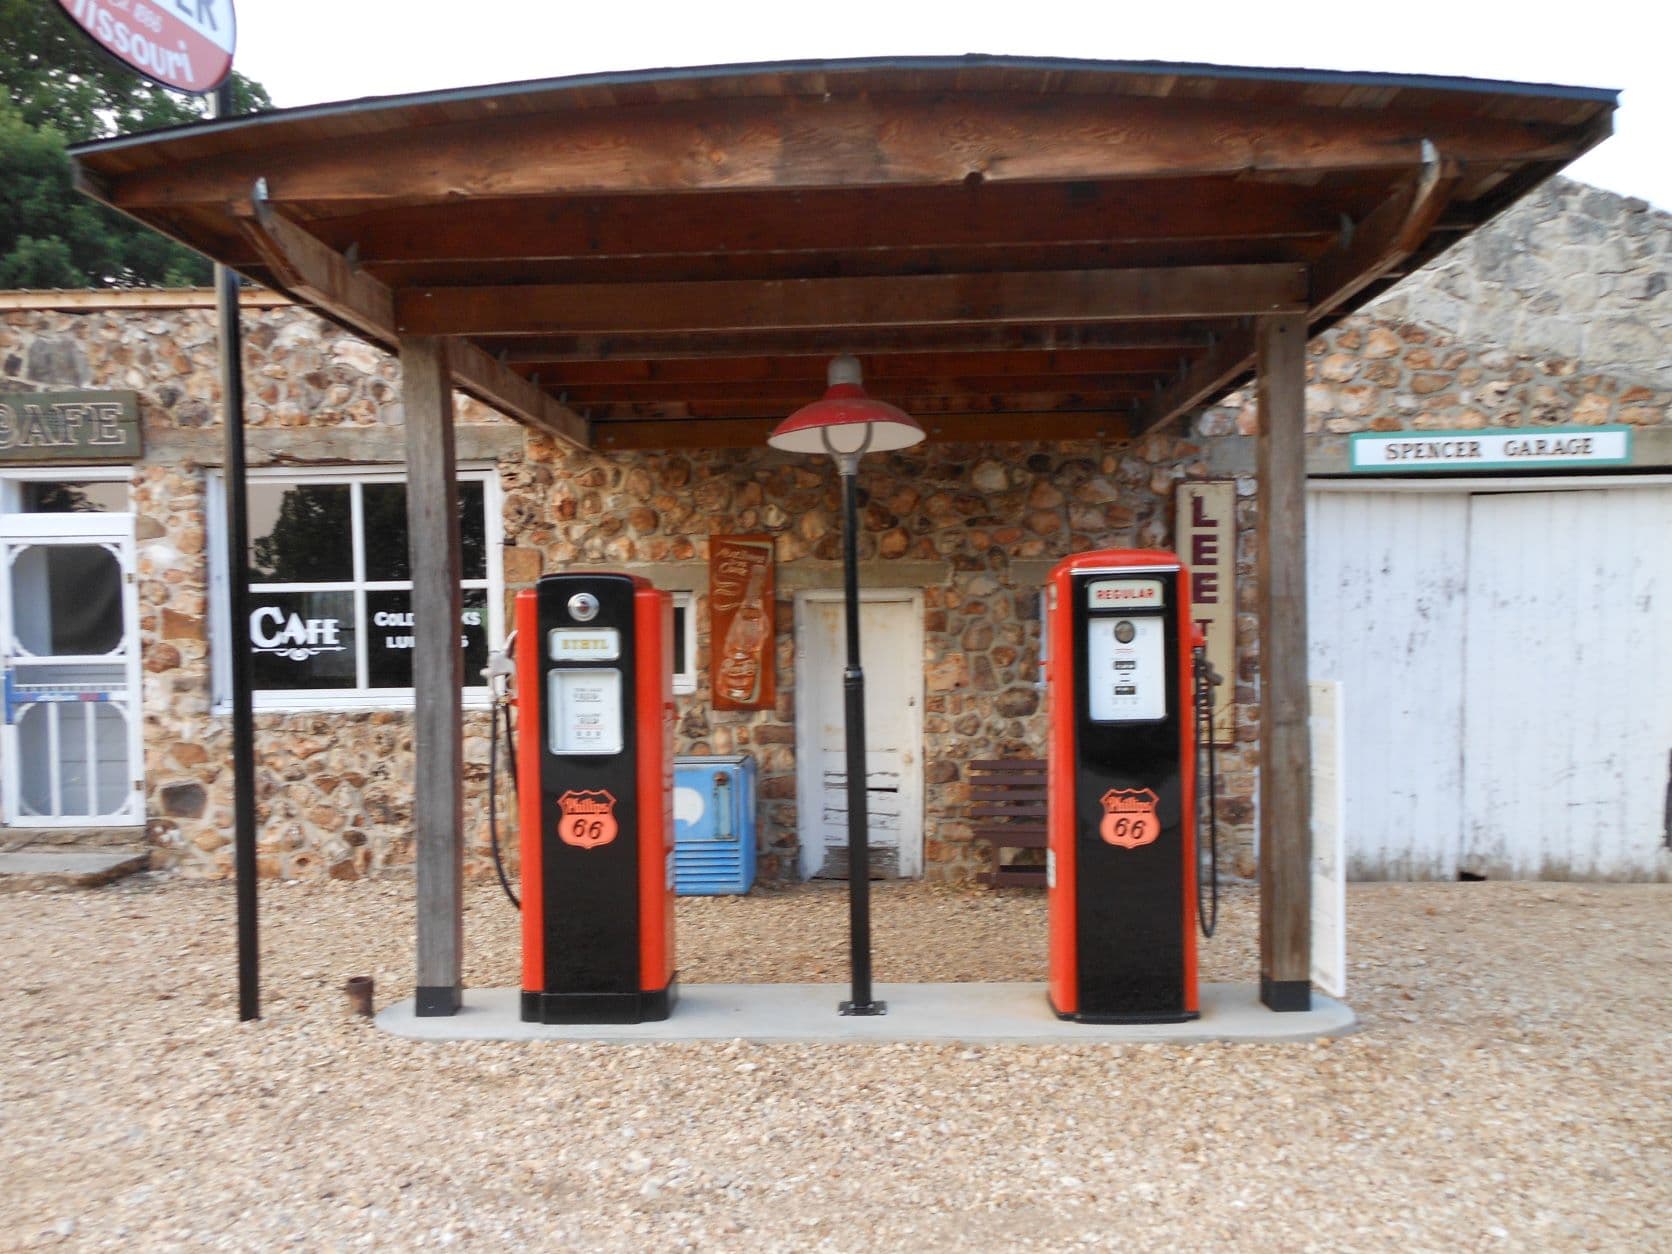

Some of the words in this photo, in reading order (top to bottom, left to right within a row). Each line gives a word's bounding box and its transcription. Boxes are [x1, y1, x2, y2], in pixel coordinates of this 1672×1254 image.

[1385, 440, 1482, 461] SPENCER
[1503, 437, 1594, 457] GARAGE
[1096, 588, 1155, 600] REGULAR
[249, 606, 341, 649] CAFE
[573, 818, 604, 840] 66
[1114, 818, 1146, 840] 66
